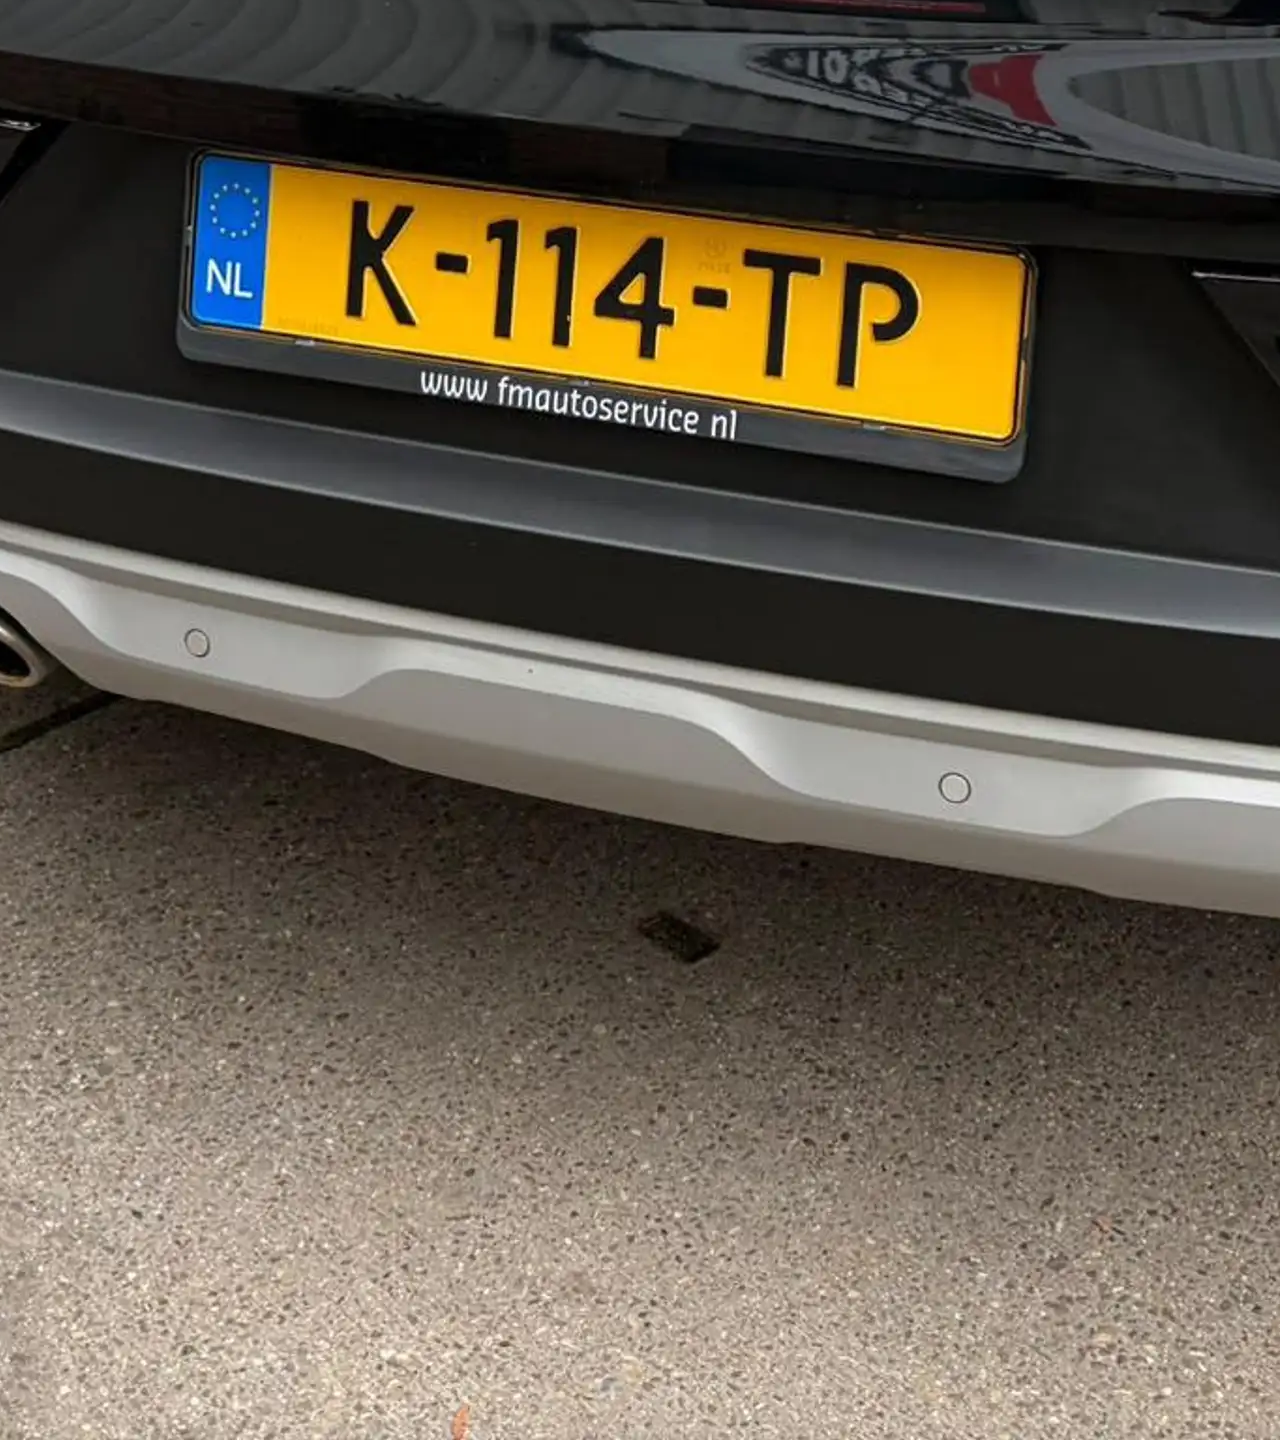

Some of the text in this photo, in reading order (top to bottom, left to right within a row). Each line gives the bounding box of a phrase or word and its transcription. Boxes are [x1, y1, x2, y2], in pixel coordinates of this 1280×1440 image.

[206, 259, 253, 298] NL
[345, 199, 920, 389] K-114-TP
[420, 370, 737, 441] www fmautoservice nl
